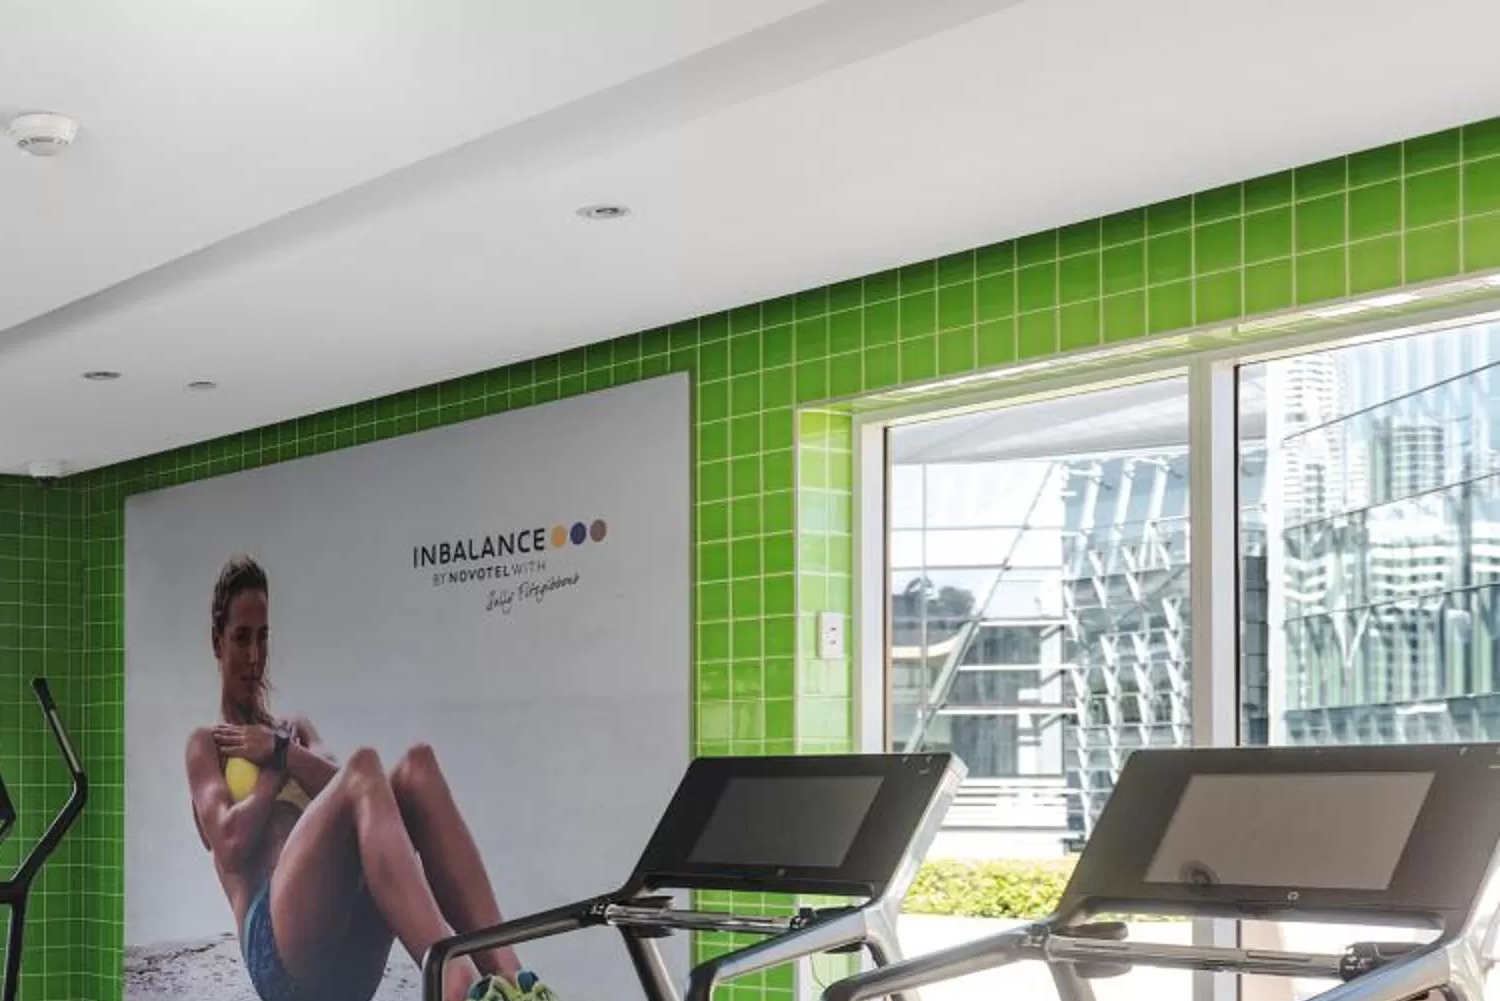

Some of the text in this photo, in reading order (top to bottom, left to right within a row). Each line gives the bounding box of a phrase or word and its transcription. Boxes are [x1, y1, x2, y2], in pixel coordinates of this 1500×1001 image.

[412, 527, 546, 568] INBALANCE
[432, 560, 548, 587] BY NOVOTEL WITH
